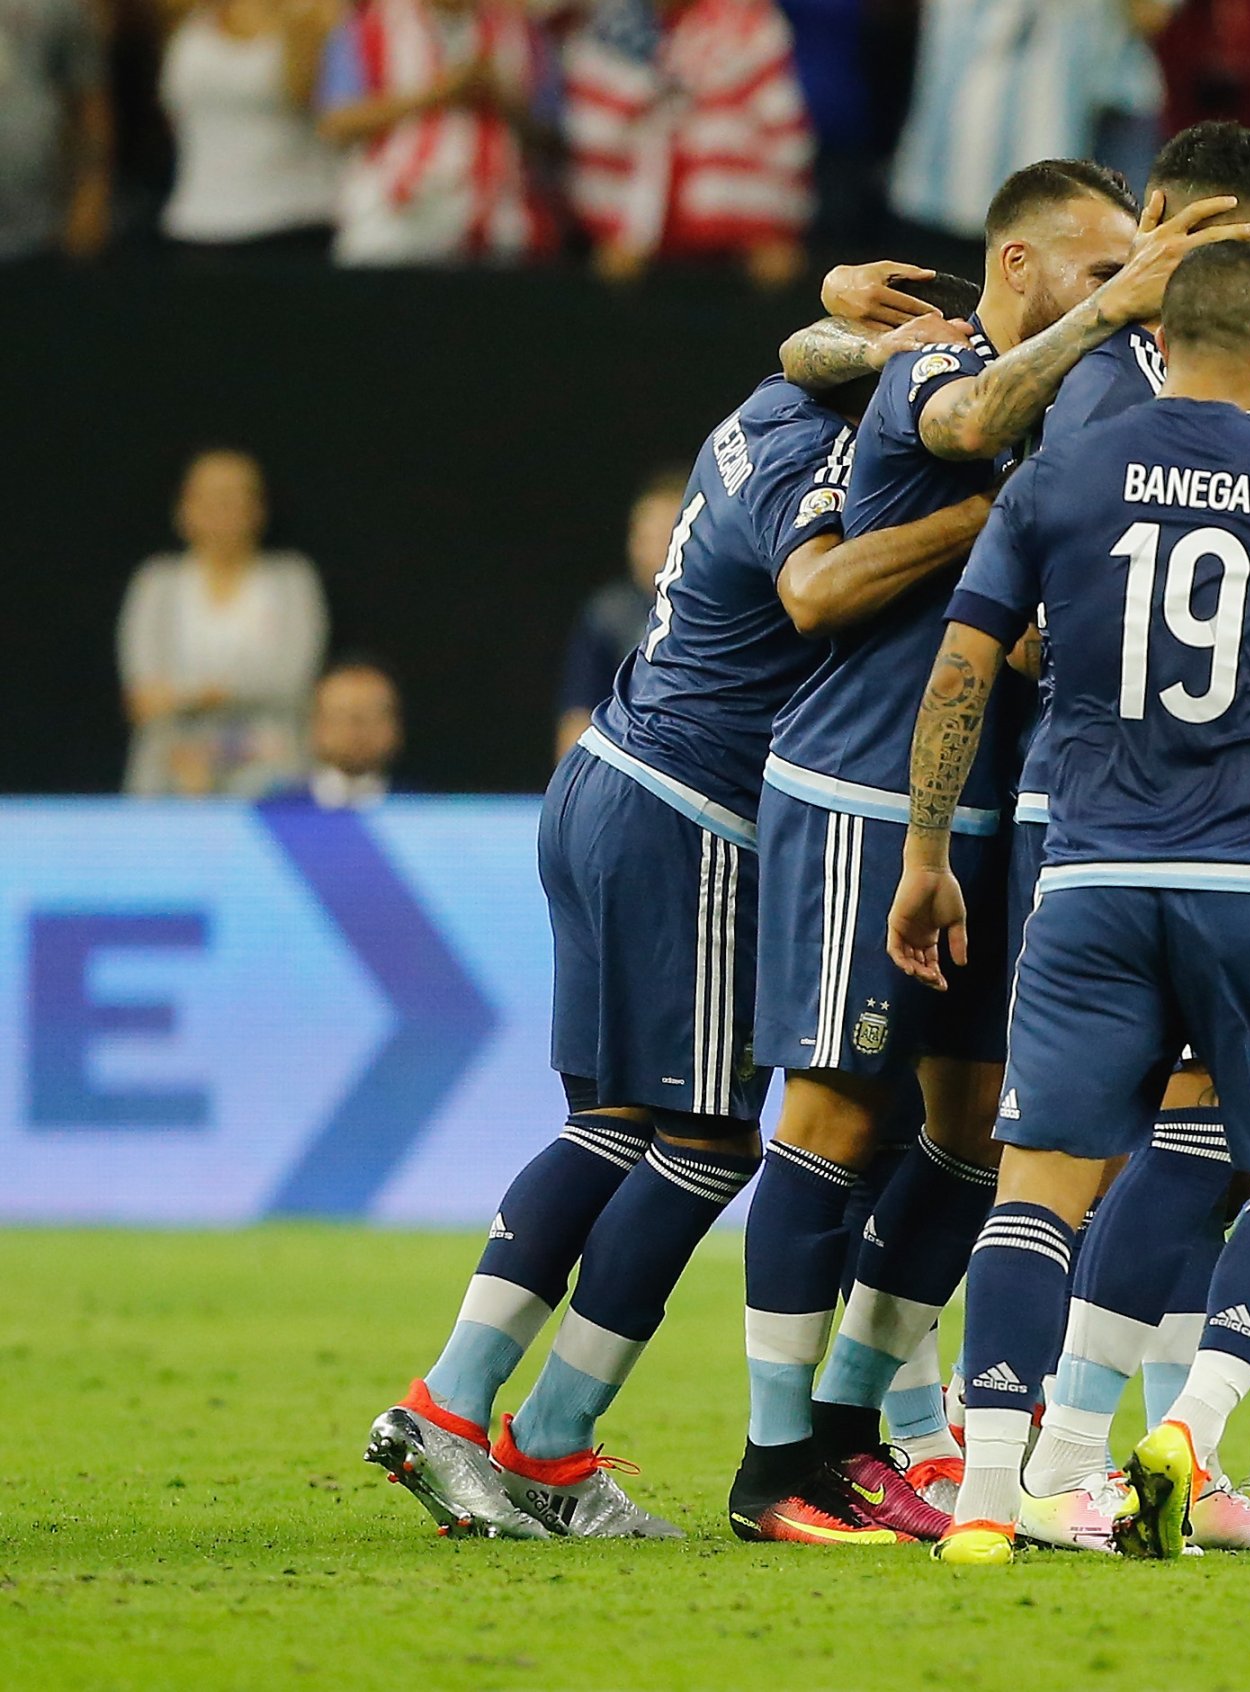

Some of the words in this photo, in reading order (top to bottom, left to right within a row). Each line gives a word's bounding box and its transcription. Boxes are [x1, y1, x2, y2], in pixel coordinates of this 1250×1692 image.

[712, 411, 754, 497] MERCADO
[1123, 463, 1250, 514] BANEGA
[28, 910, 211, 1130] E
[972, 1377, 1028, 1394] adidas
